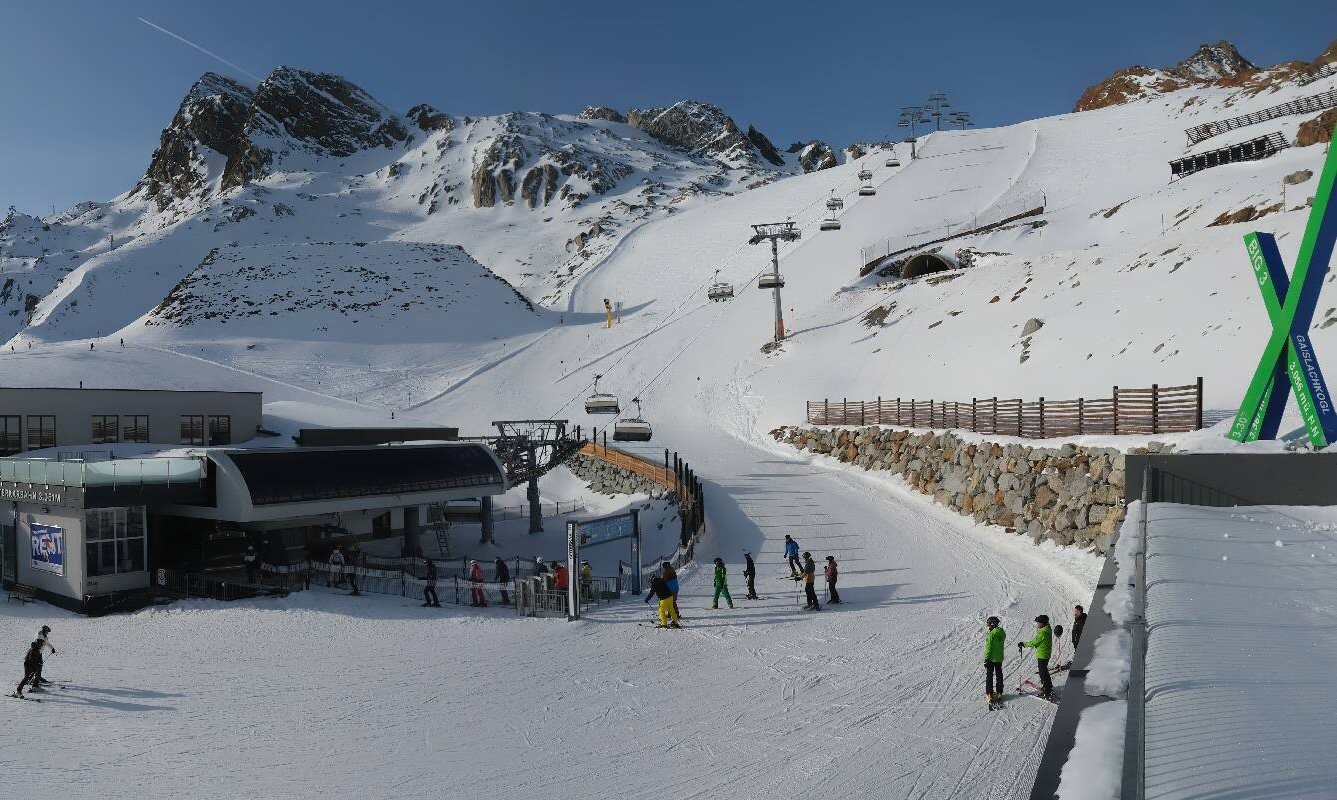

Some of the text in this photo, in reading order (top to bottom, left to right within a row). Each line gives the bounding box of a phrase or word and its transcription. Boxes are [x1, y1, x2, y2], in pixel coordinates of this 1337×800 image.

[1248, 239, 1268, 286] BIG 3
[1289, 361, 1303, 393] 3.056
[1296, 334, 1327, 416] GAISLACHKOGL
[1232, 411, 1248, 438] 3.30
